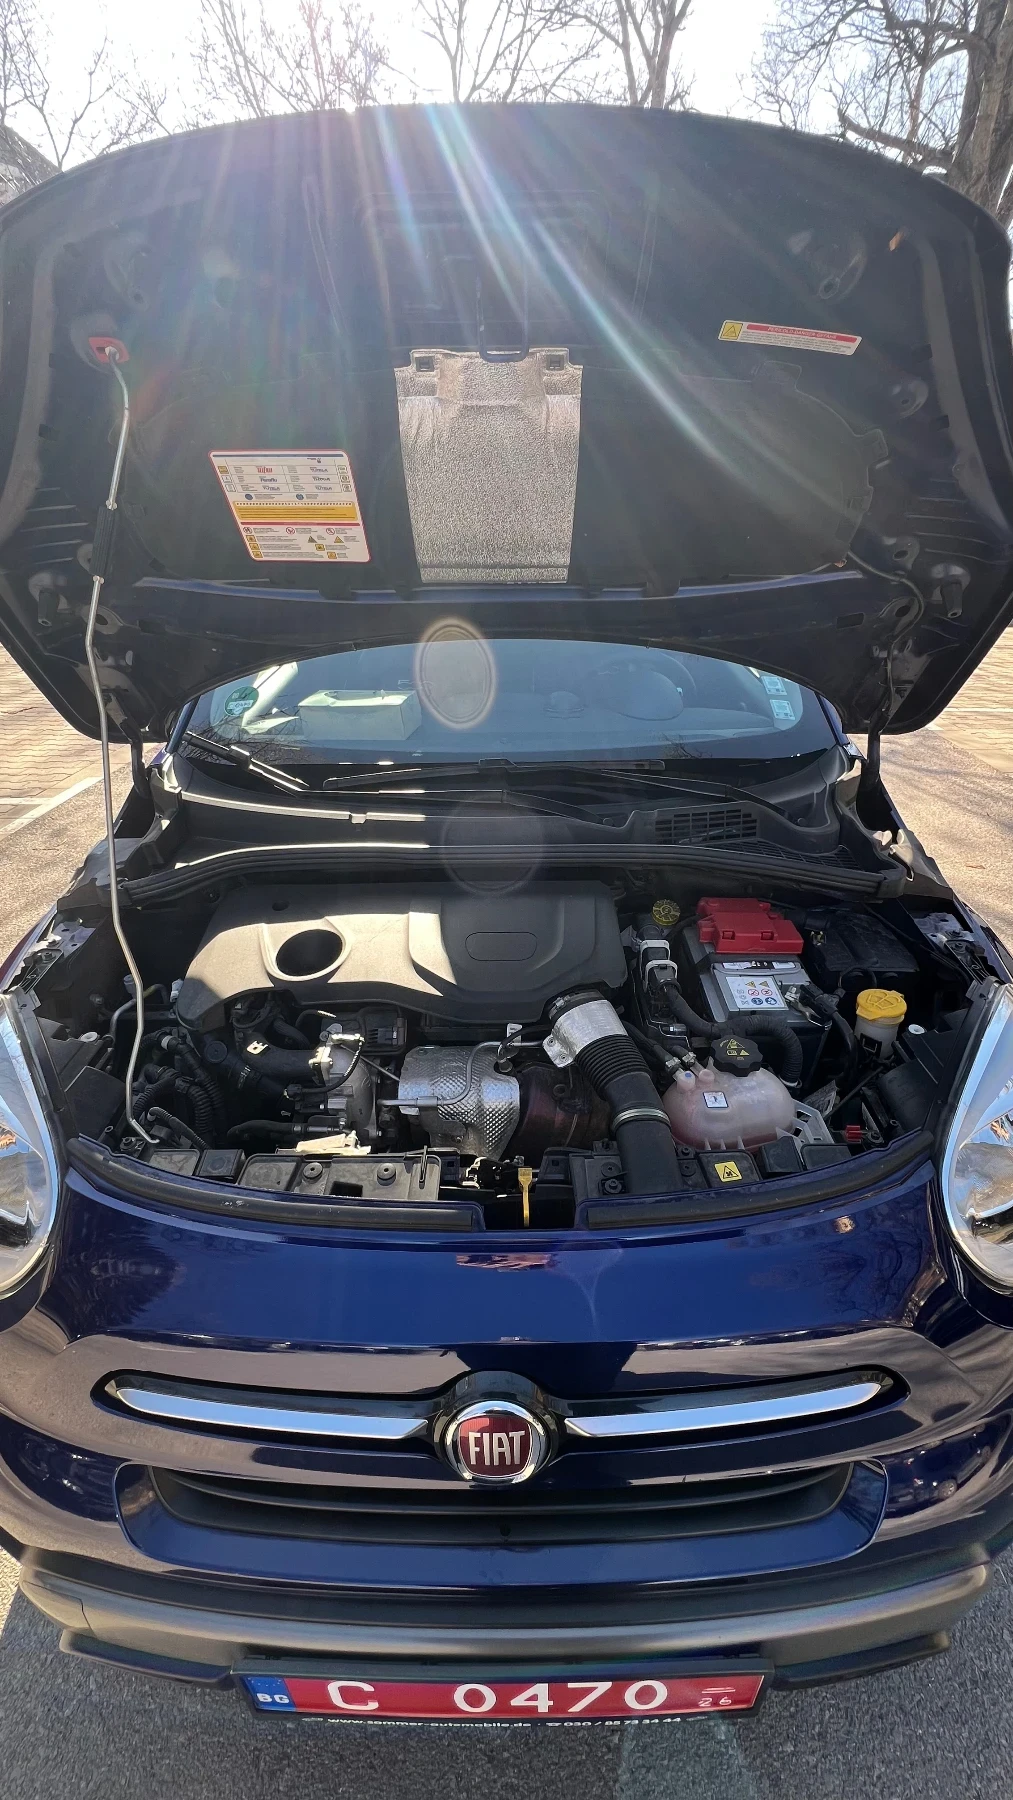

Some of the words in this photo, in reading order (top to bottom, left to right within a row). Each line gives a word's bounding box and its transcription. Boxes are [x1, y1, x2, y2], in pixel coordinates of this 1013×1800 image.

[468, 1430, 526, 1466] FIAT
[256, 1693, 289, 1704] BG
[327, 1680, 379, 1711] C
[453, 1680, 668, 1713] 0470
[327, 1718, 532, 1728] www.sommer-automobile.de
